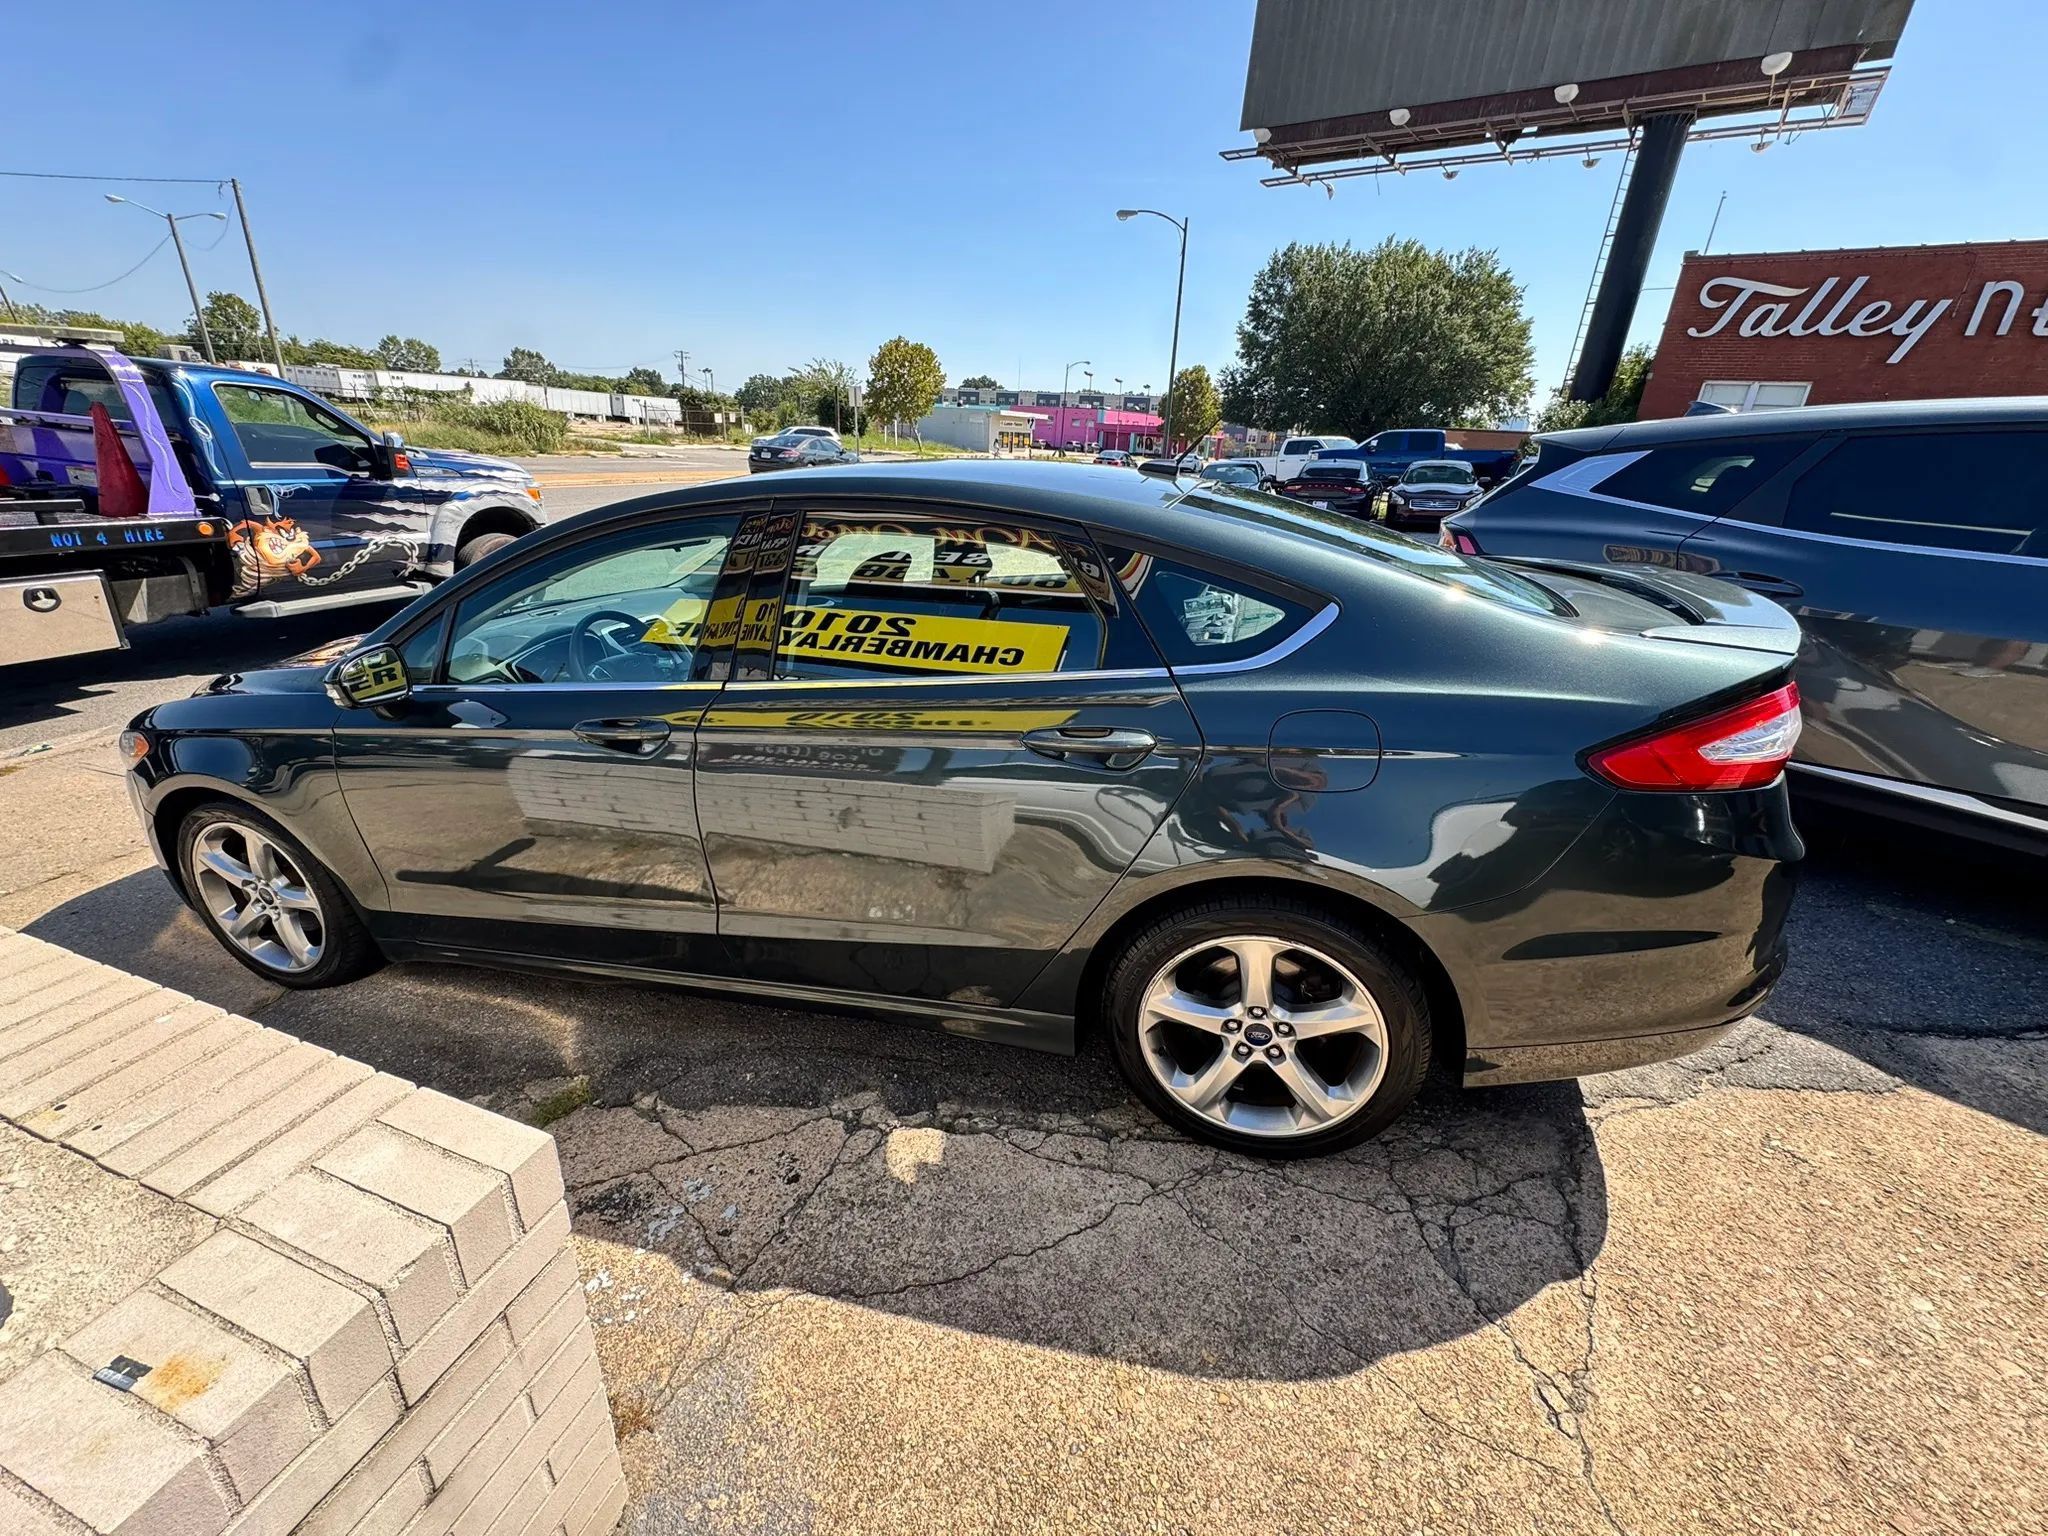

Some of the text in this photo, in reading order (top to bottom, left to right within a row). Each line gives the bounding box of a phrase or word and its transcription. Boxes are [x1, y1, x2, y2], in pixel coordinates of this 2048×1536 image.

[1687, 275, 1953, 364] Talley
[50, 527, 166, 547] NOT 4 HIRE
